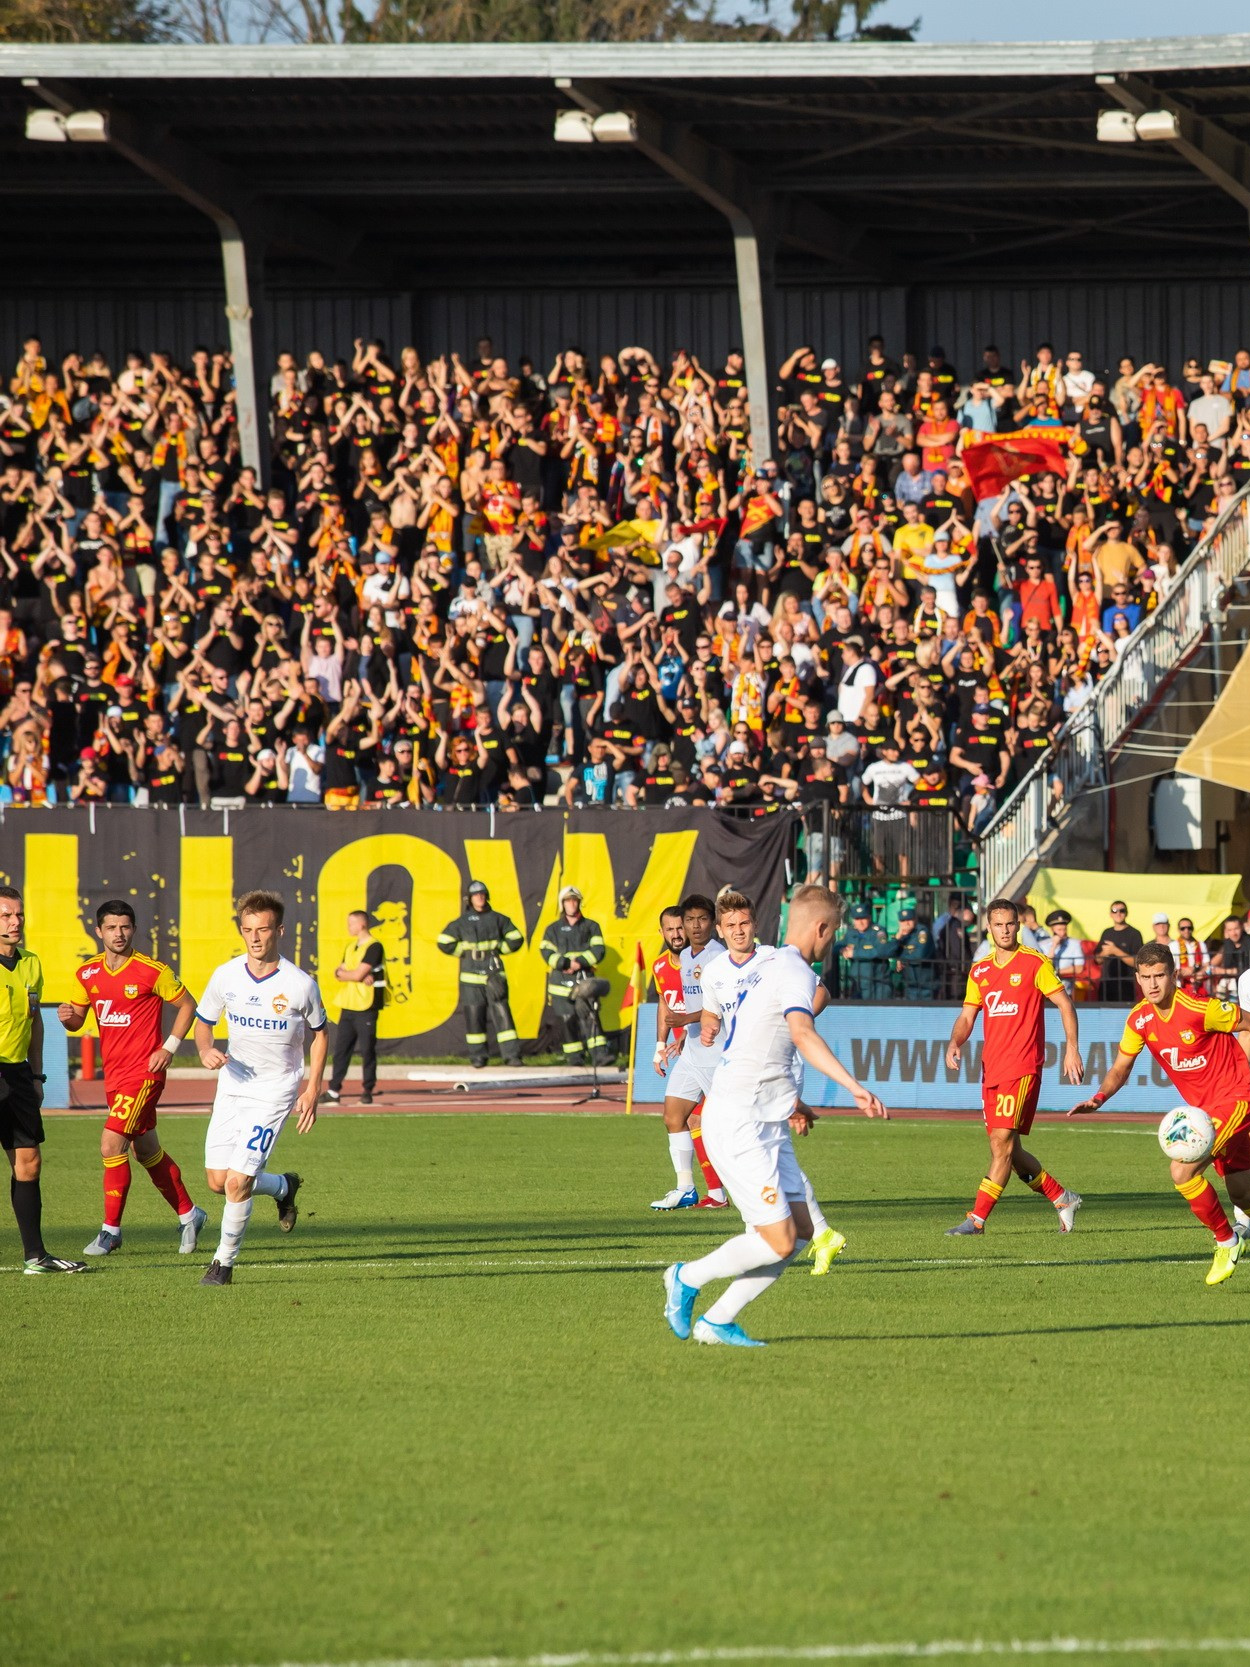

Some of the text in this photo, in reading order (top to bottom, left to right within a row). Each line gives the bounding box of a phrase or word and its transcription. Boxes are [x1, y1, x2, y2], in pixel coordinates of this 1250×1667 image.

[233, 1014, 287, 1030] РОССЕТИ
[109, 1094, 135, 1120] 23
[995, 1094, 1015, 1117] 20
[246, 1125, 274, 1153] 20
